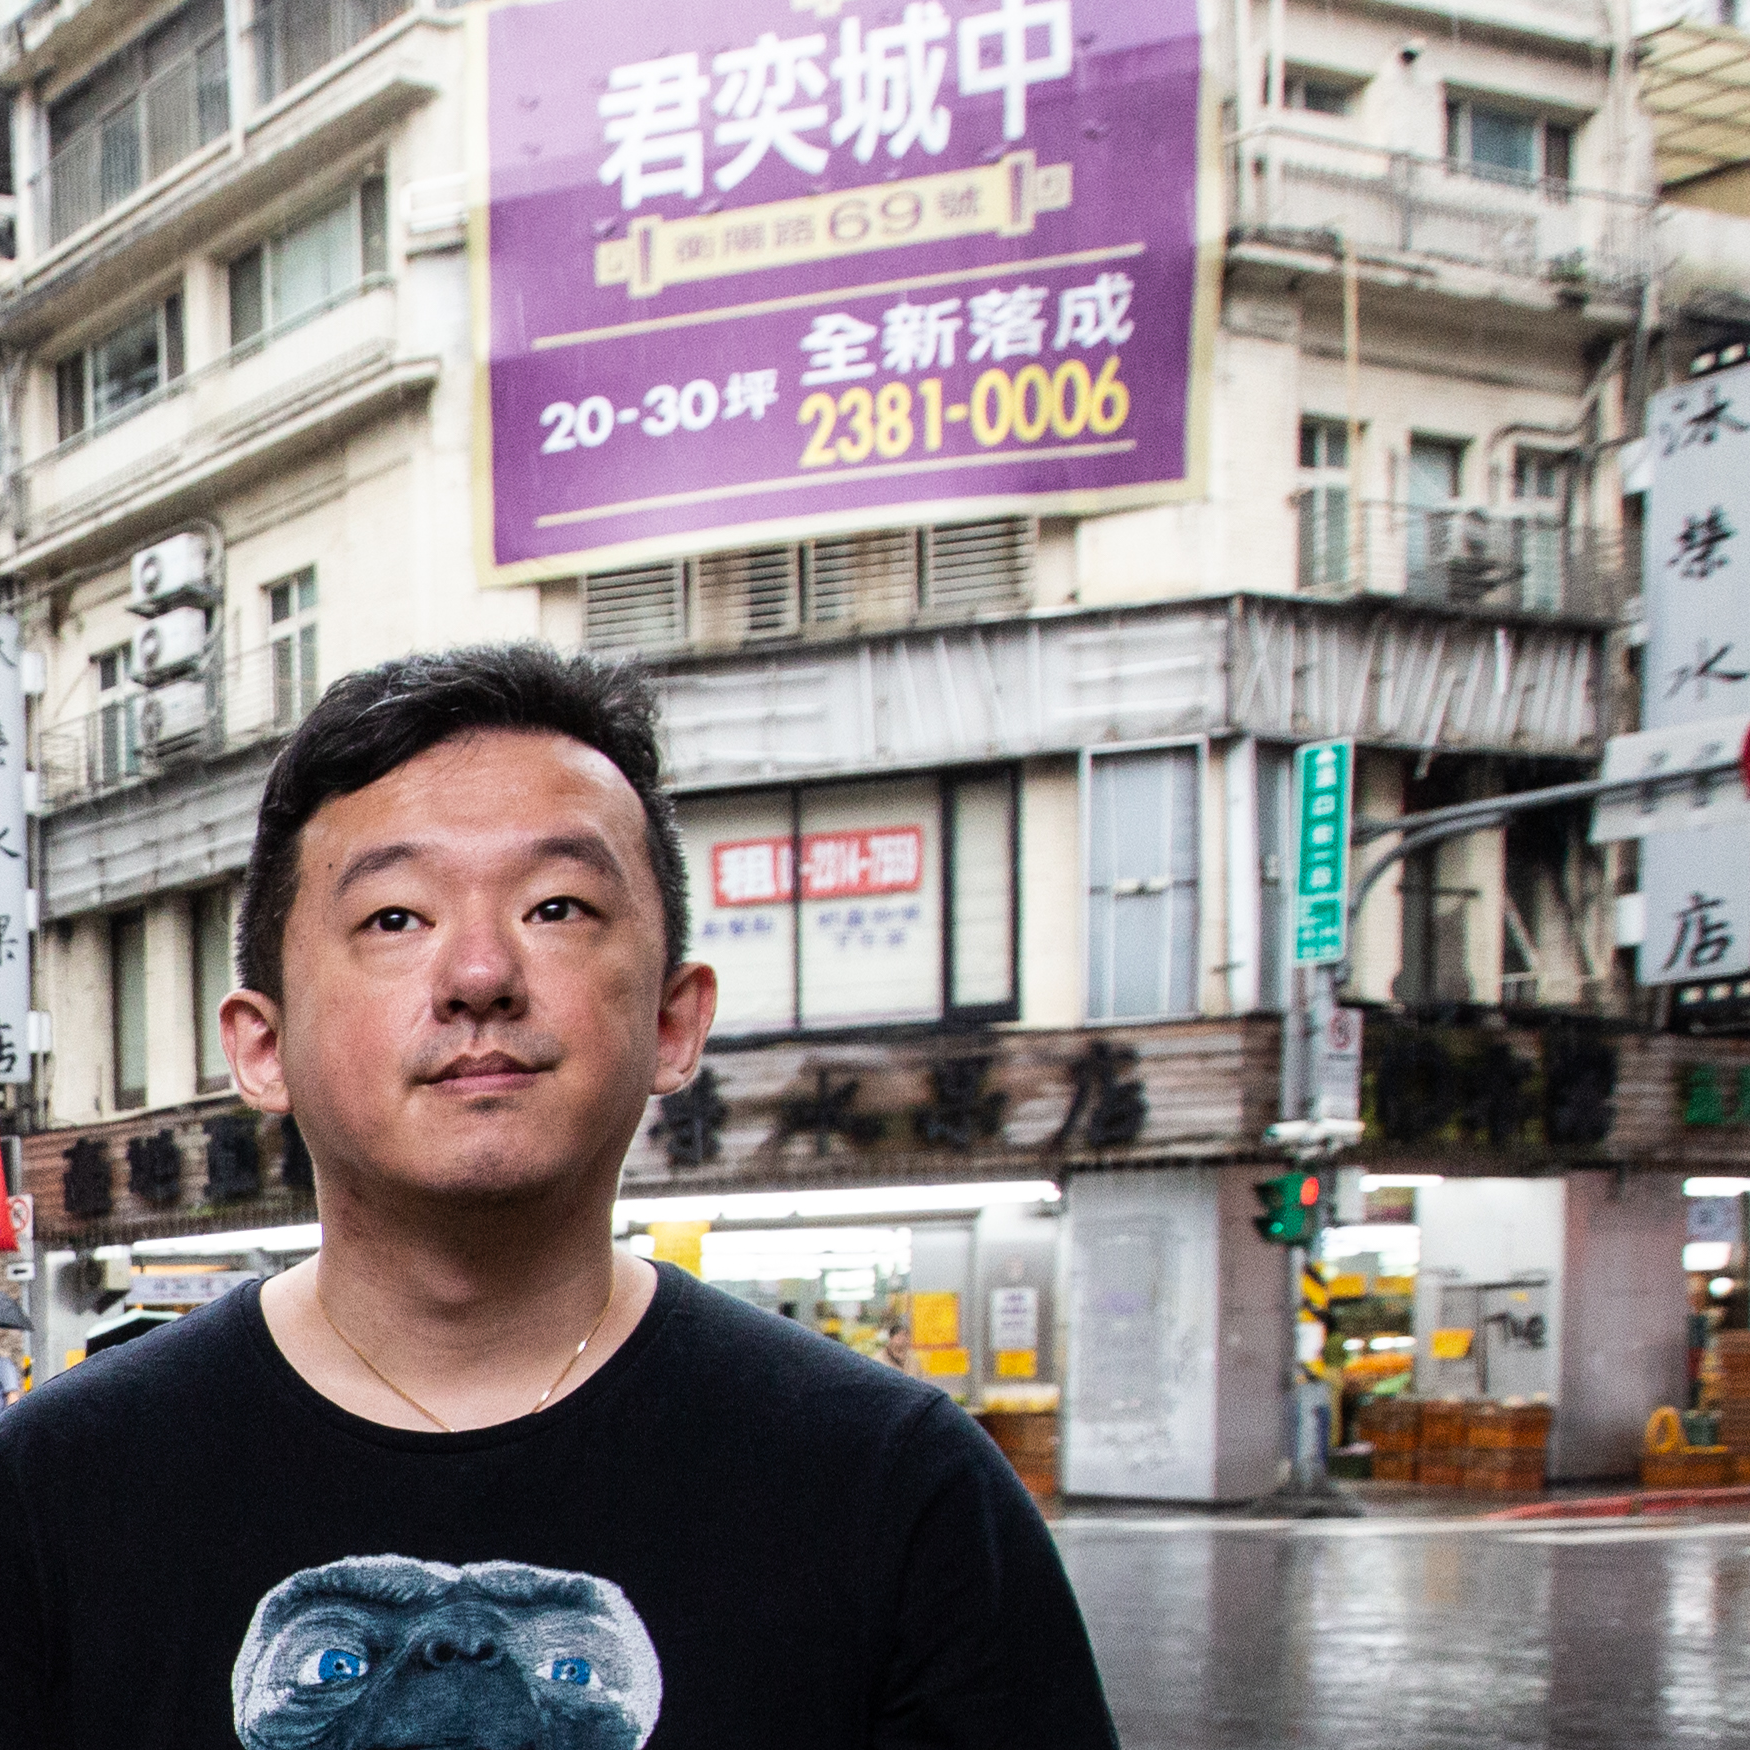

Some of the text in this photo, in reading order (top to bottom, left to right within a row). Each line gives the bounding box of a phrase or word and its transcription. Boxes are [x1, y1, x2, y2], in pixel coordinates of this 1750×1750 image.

[598, 0, 1074, 209] 君奕城中
[798, 273, 1137, 386] 全新落成
[540, 367, 780, 454] 20-30坪
[798, 356, 1130, 469] 2381-0006
